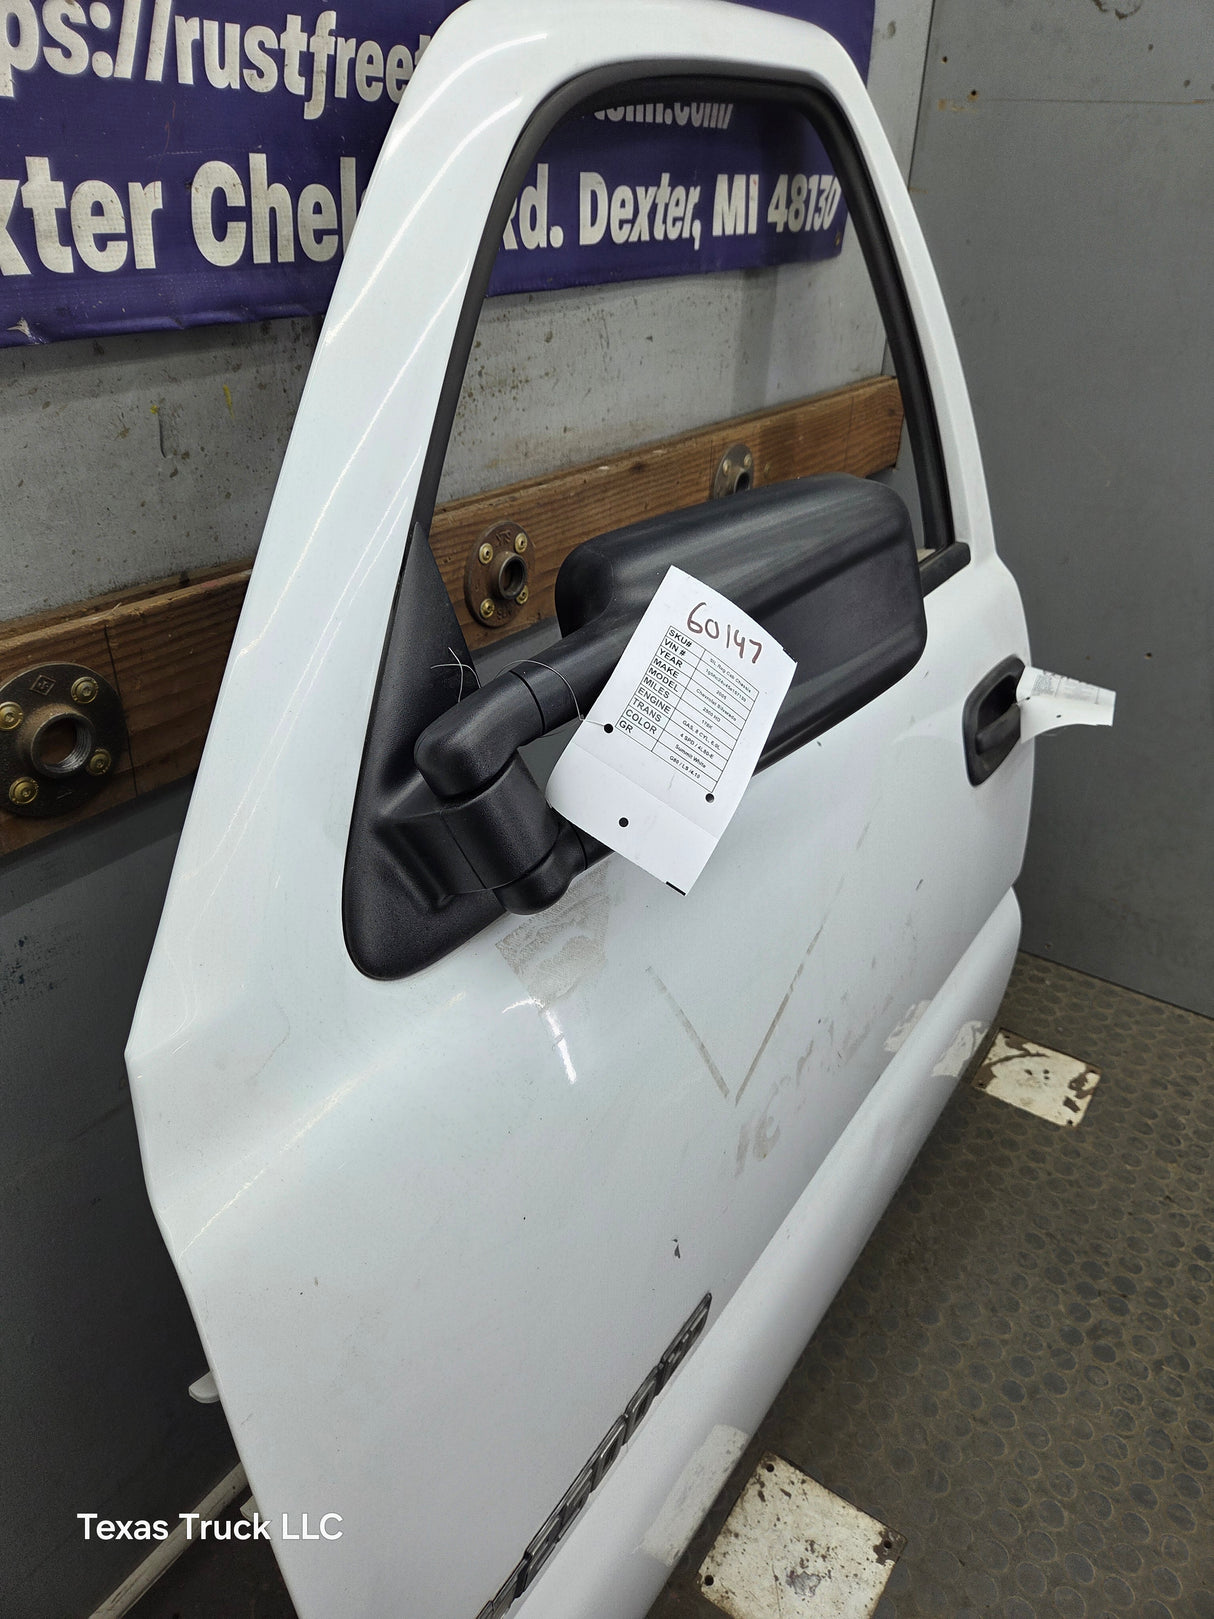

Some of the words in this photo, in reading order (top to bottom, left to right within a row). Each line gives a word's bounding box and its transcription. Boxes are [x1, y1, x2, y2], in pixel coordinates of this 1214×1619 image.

[191, 152, 367, 267] Chel
[579, 171, 701, 251] Dexter,
[712, 174, 760, 236] MI
[767, 174, 842, 233] 48130
[668, 629, 693, 648] SKU#
[687, 602, 763, 665] 60147
[659, 648, 683, 668] YEAR
[664, 638, 679, 652] VIN
[679, 649, 686, 657] #
[653, 658, 680, 679] MAKE
[637, 686, 671, 715] ENGINE
[643, 676, 670, 699] MILES
[648, 667, 678, 693] MODEL
[702, 706, 714, 717] 2500
[619, 719, 634, 734] GR
[632, 697, 662, 723] TRANS
[683, 735, 695, 746] SPD
[625, 709, 657, 735] COLOR
[674, 743, 694, 760] Summit
[692, 756, 707, 769] White
